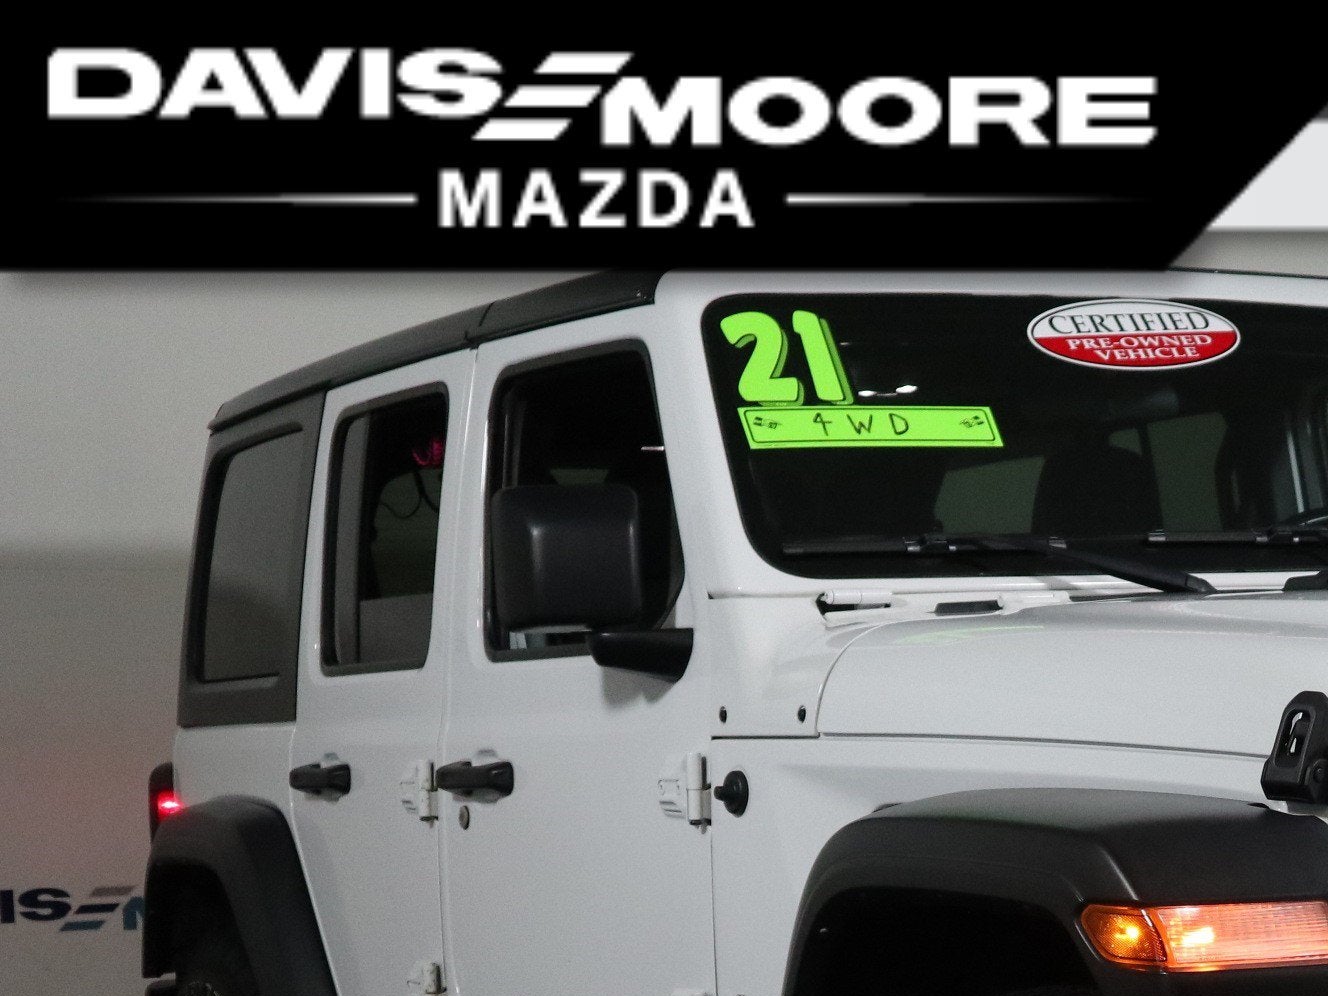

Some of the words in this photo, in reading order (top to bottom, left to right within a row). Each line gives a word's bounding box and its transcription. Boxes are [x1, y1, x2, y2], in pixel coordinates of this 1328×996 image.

[1049, 311, 1210, 334] CERTIFIED
[1066, 334, 1212, 350] PRE-OWNED
[719, 309, 854, 406] 21
[1094, 346, 1200, 361] VEHICLE
